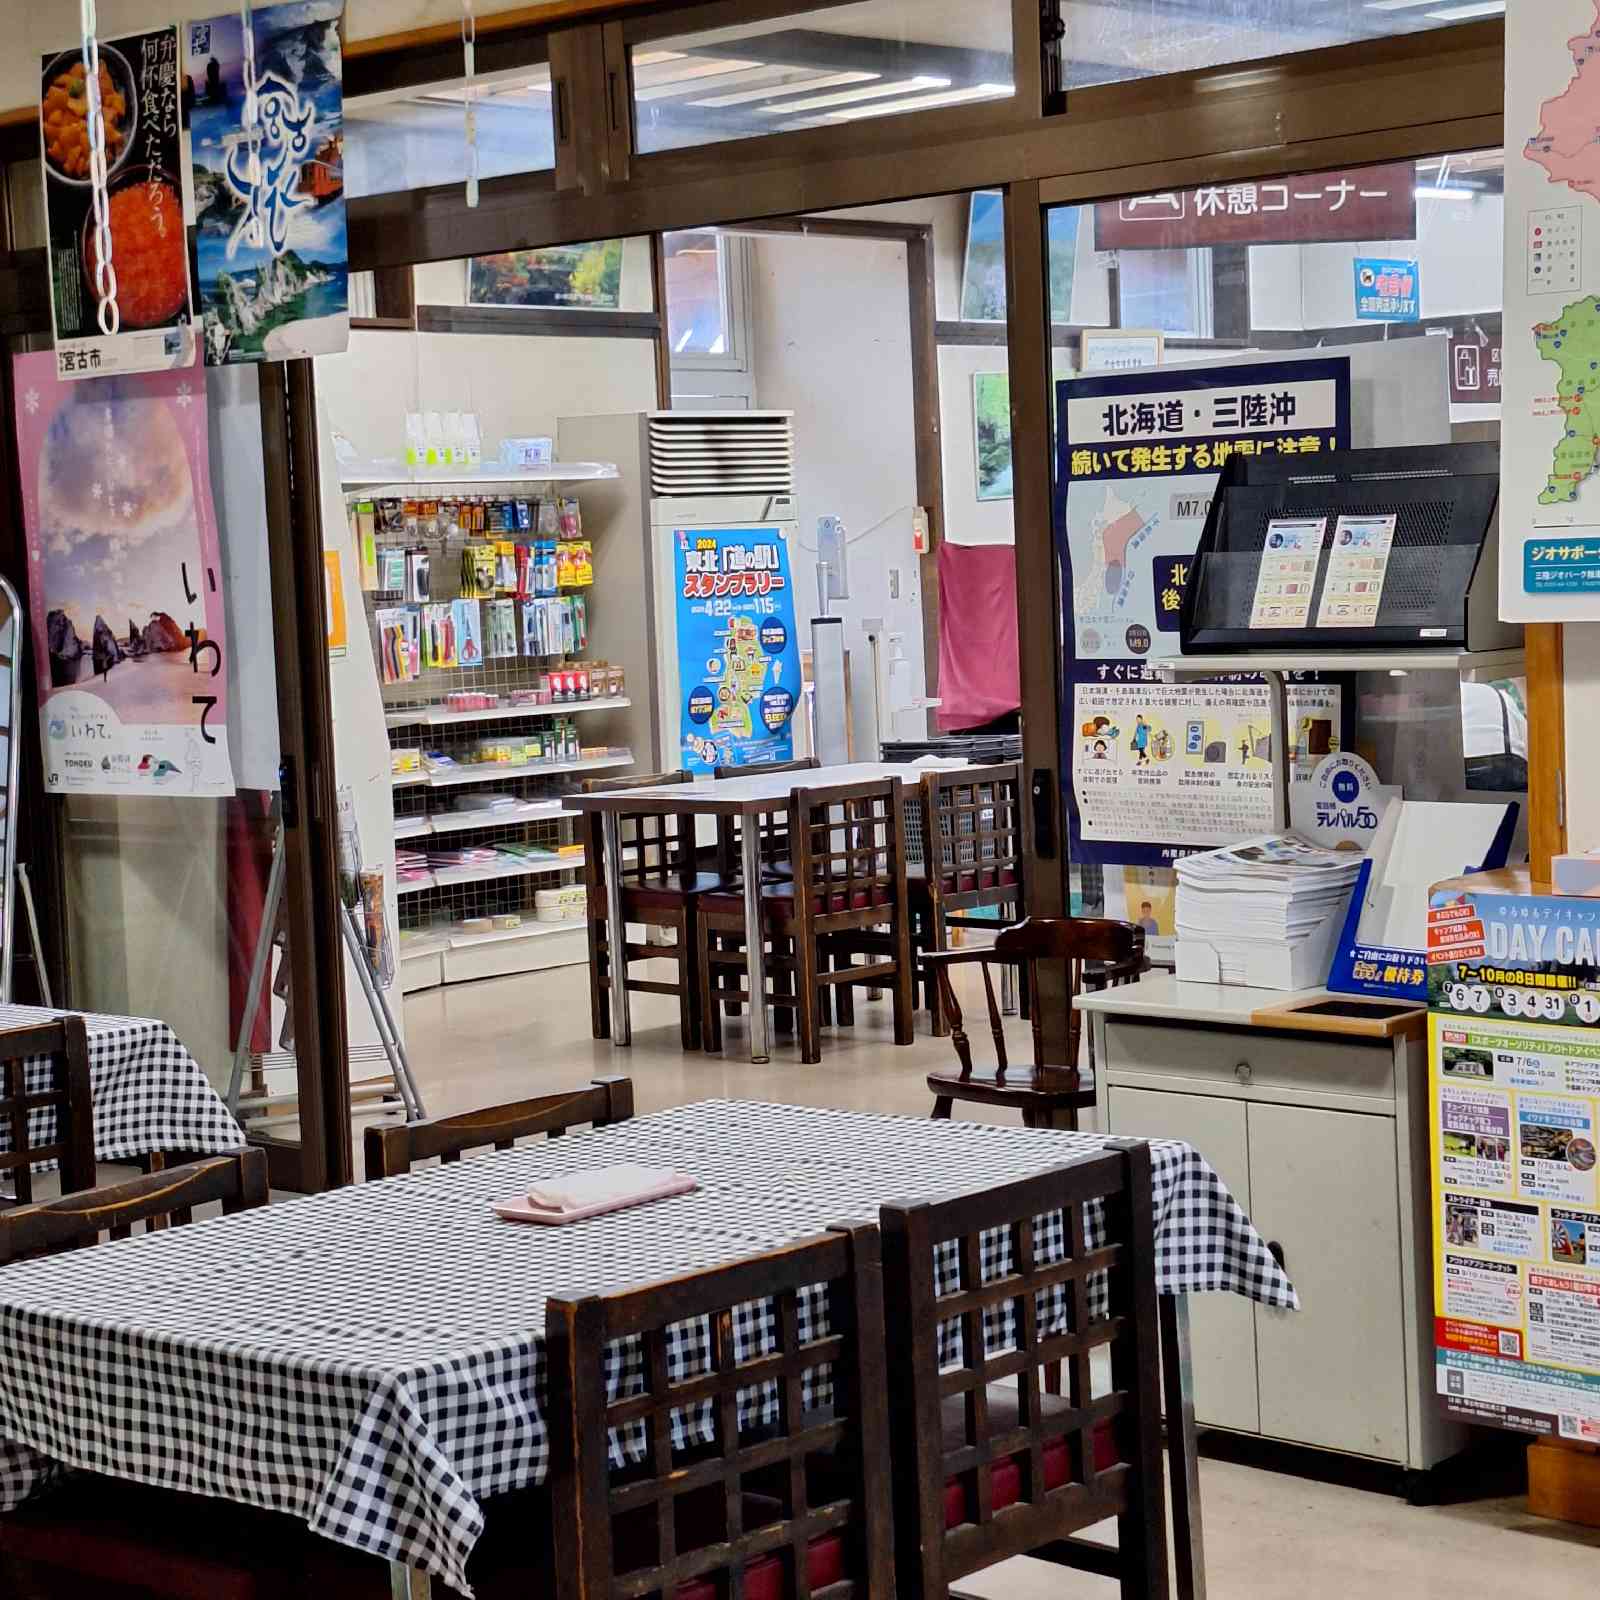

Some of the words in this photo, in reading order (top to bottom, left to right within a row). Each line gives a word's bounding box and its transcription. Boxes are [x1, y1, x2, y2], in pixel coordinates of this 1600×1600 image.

[159, 34, 177, 138] 弁慶なら
[1193, 178, 1388, 217] 休憩コーナー
[63, 348, 102, 372] 宮古市
[1102, 391, 1297, 437] 北海道・三陸沖
[1531, 543, 1600, 561] ジオサポー
[683, 570, 785, 598] スタンプラリー
[181, 562, 222, 745] いわて
[1316, 806, 1378, 829] テレパル50
[1490, 920, 1547, 963] DAY
[1545, 996, 1561, 1010] 31
